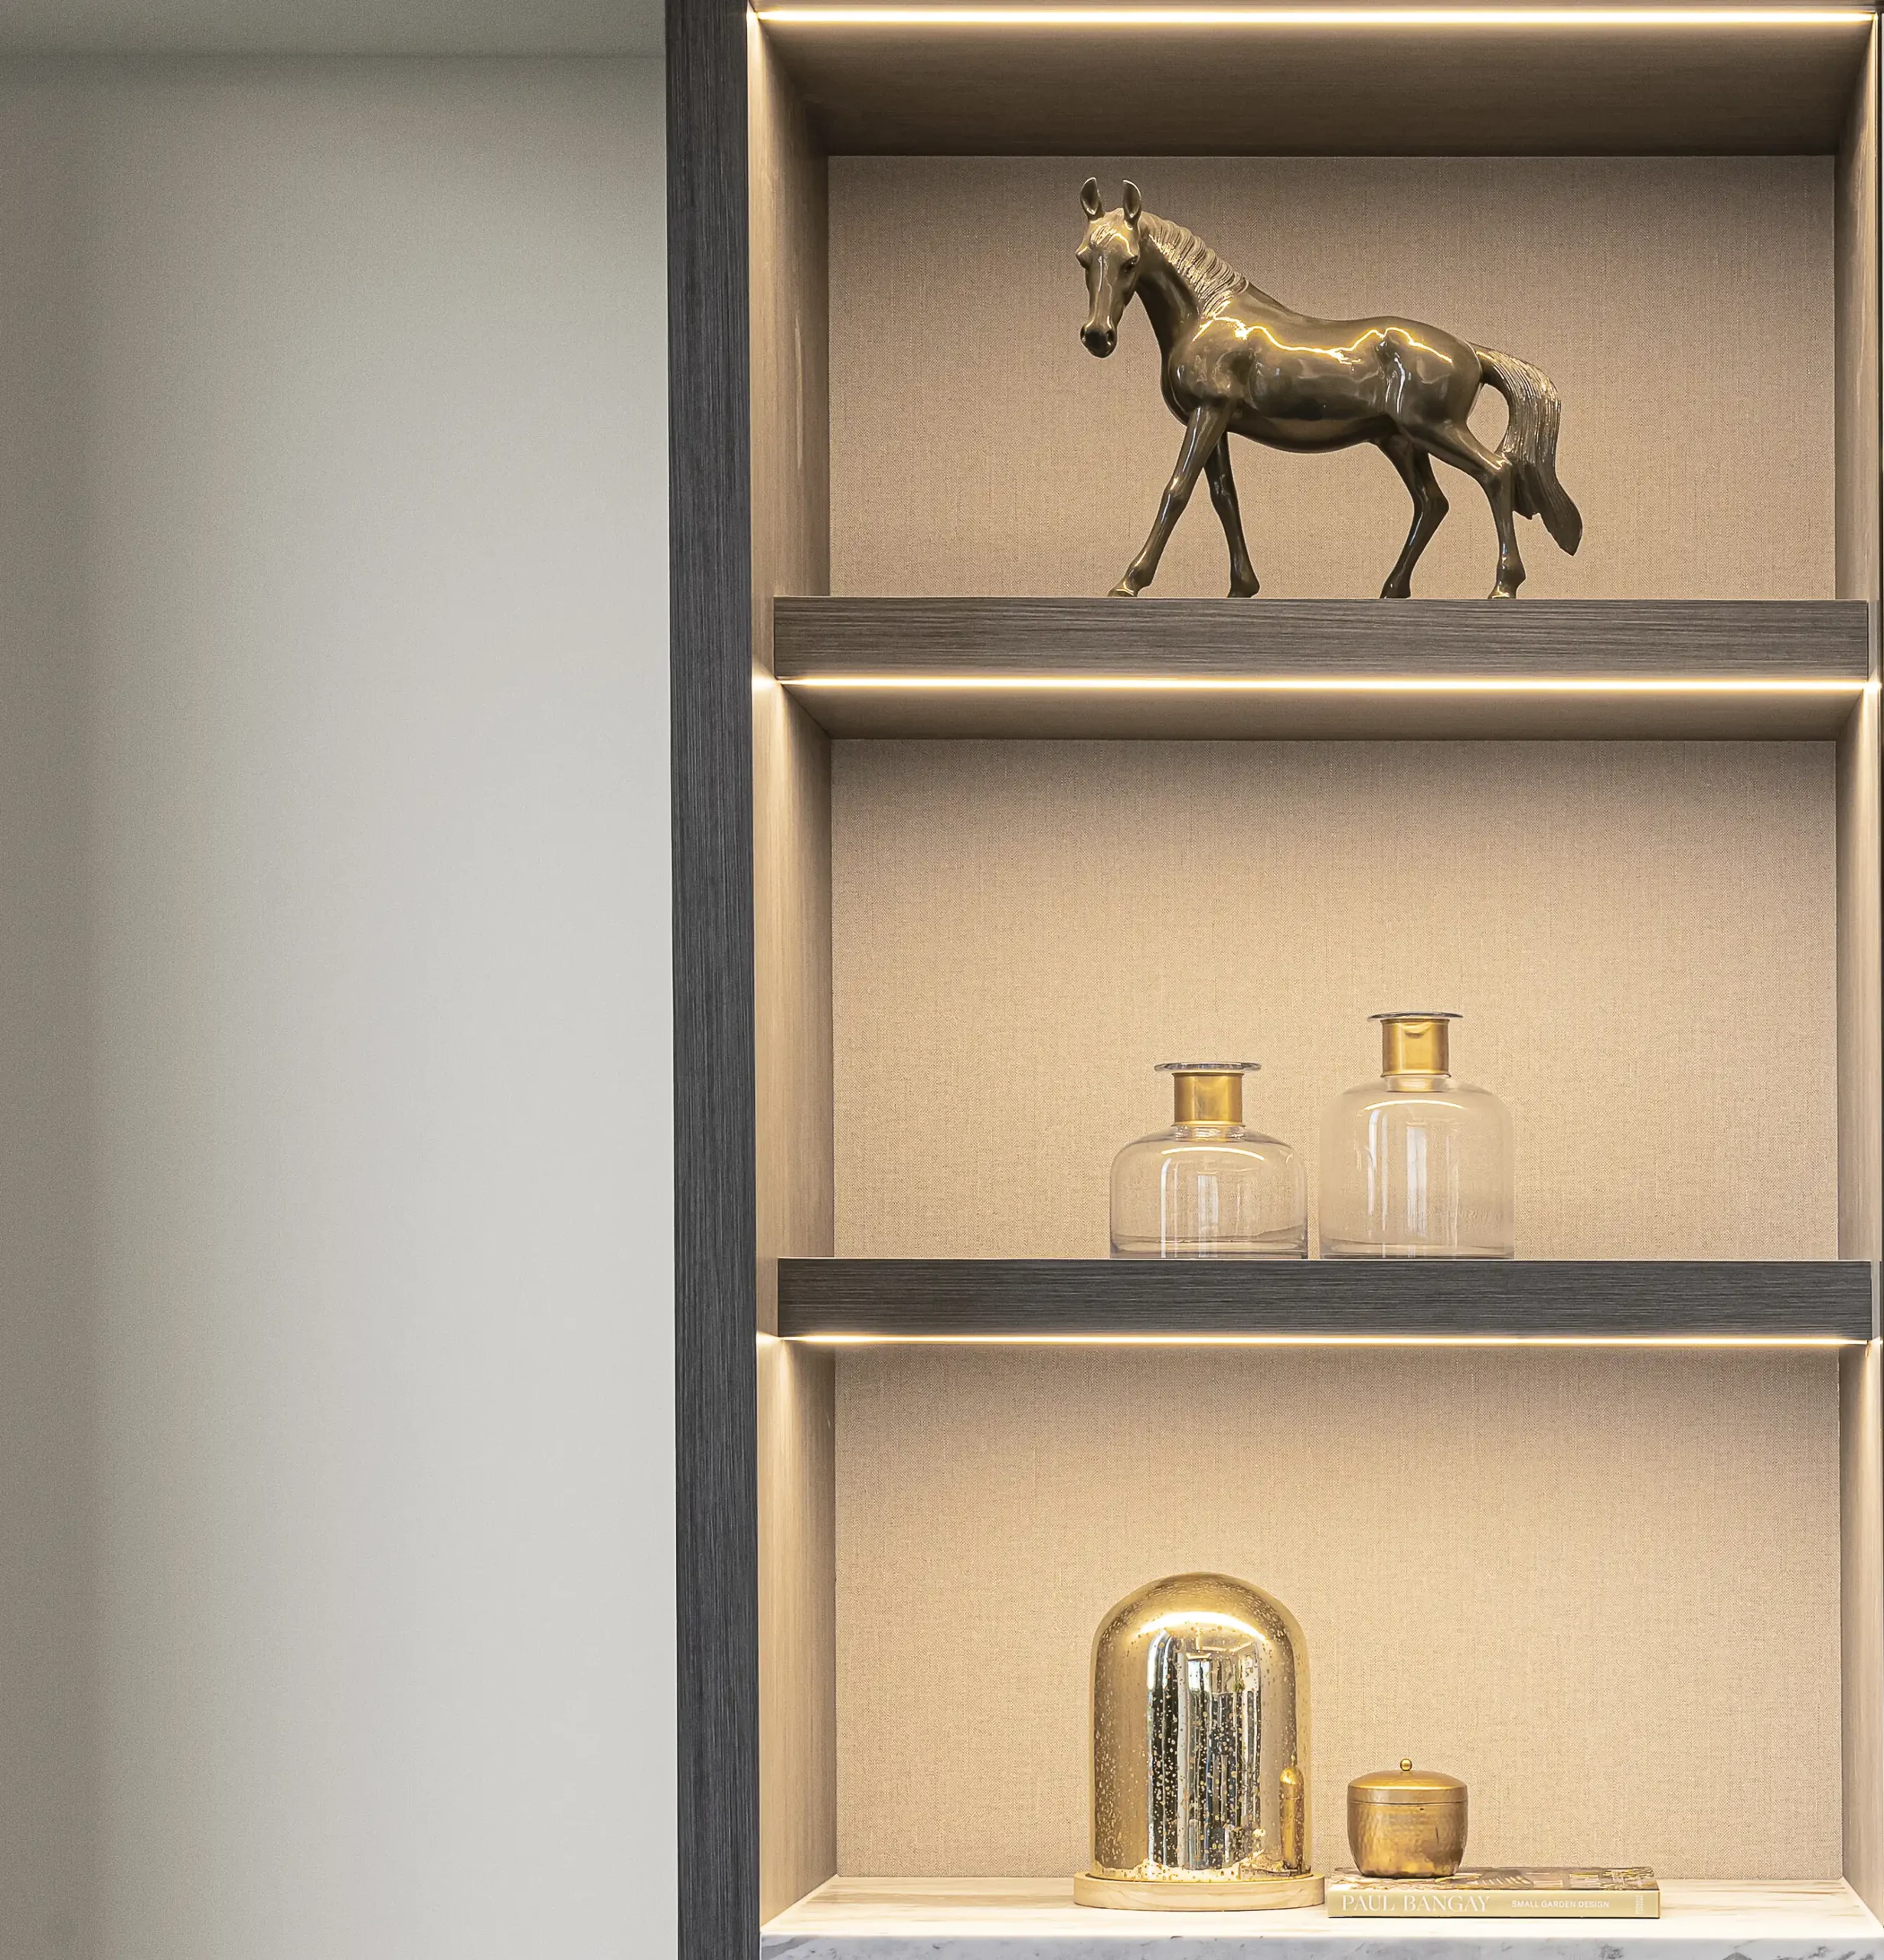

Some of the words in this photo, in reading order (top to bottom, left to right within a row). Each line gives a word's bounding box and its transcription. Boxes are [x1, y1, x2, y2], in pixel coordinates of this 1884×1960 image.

[1342, 1895, 1395, 1911] PAUL
[1404, 1895, 1490, 1913] BANGAY
[1511, 1900, 1540, 1908] SMALL
[1541, 1900, 1576, 1908] GARDEN
